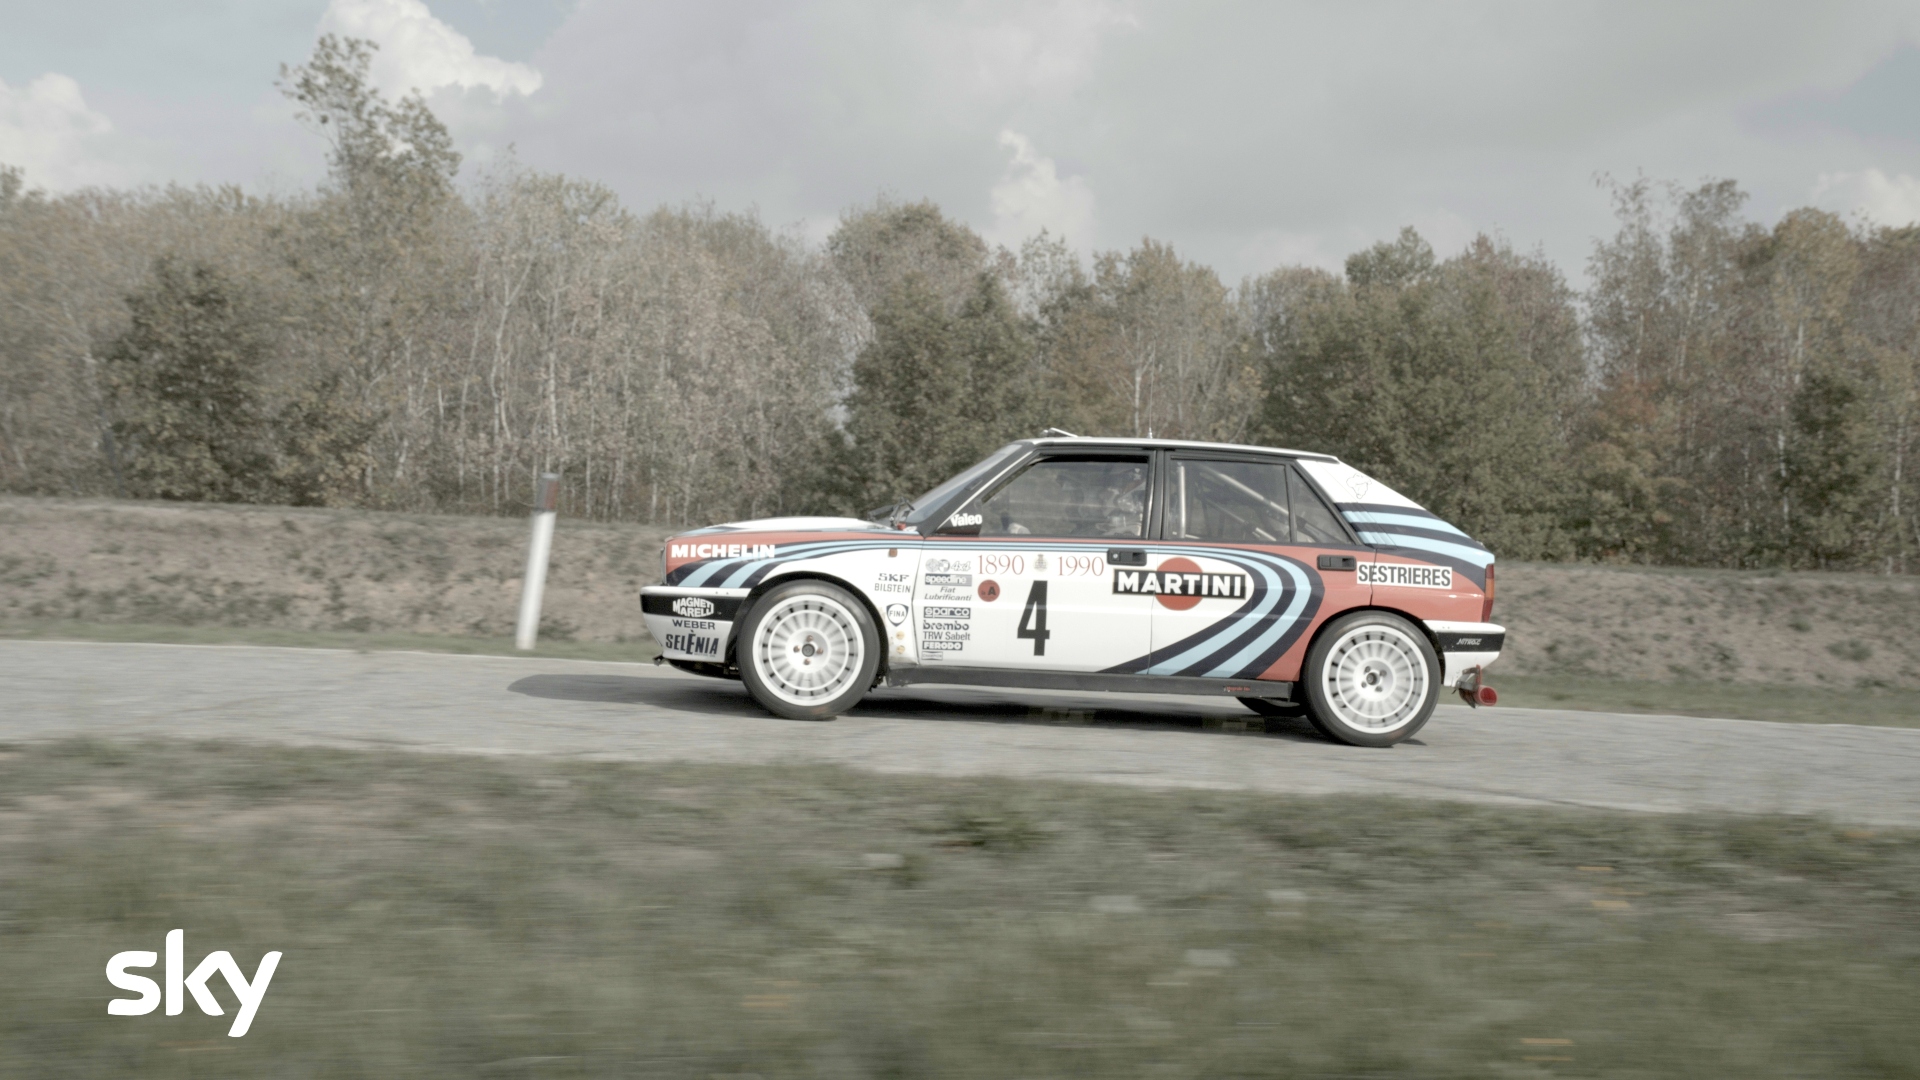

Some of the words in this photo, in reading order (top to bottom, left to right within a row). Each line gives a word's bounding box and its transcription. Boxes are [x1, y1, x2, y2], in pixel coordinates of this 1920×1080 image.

[950, 512, 983, 527] Valeo
[671, 544, 775, 559] MICHELIN
[978, 554, 1025, 575] 1890
[1057, 555, 1104, 577] 1990
[878, 573, 910, 583] SKF
[1358, 564, 1451, 586] SESTRIERES
[874, 583, 911, 594] BILSTEIN
[1117, 571, 1241, 597] MARTINI
[940, 586, 956, 594] Fiat
[672, 596, 714, 608] MAGNETI
[924, 593, 972, 602] Lubrificanti
[888, 610, 906, 618] FINA
[925, 607, 970, 618] sparco
[1017, 580, 1050, 656] 4
[672, 619, 715, 630] WEBER
[922, 620, 970, 631] brembo
[922, 631, 943, 640] TRW
[944, 631, 970, 641] Sabelt
[923, 641, 962, 650] FERODO
